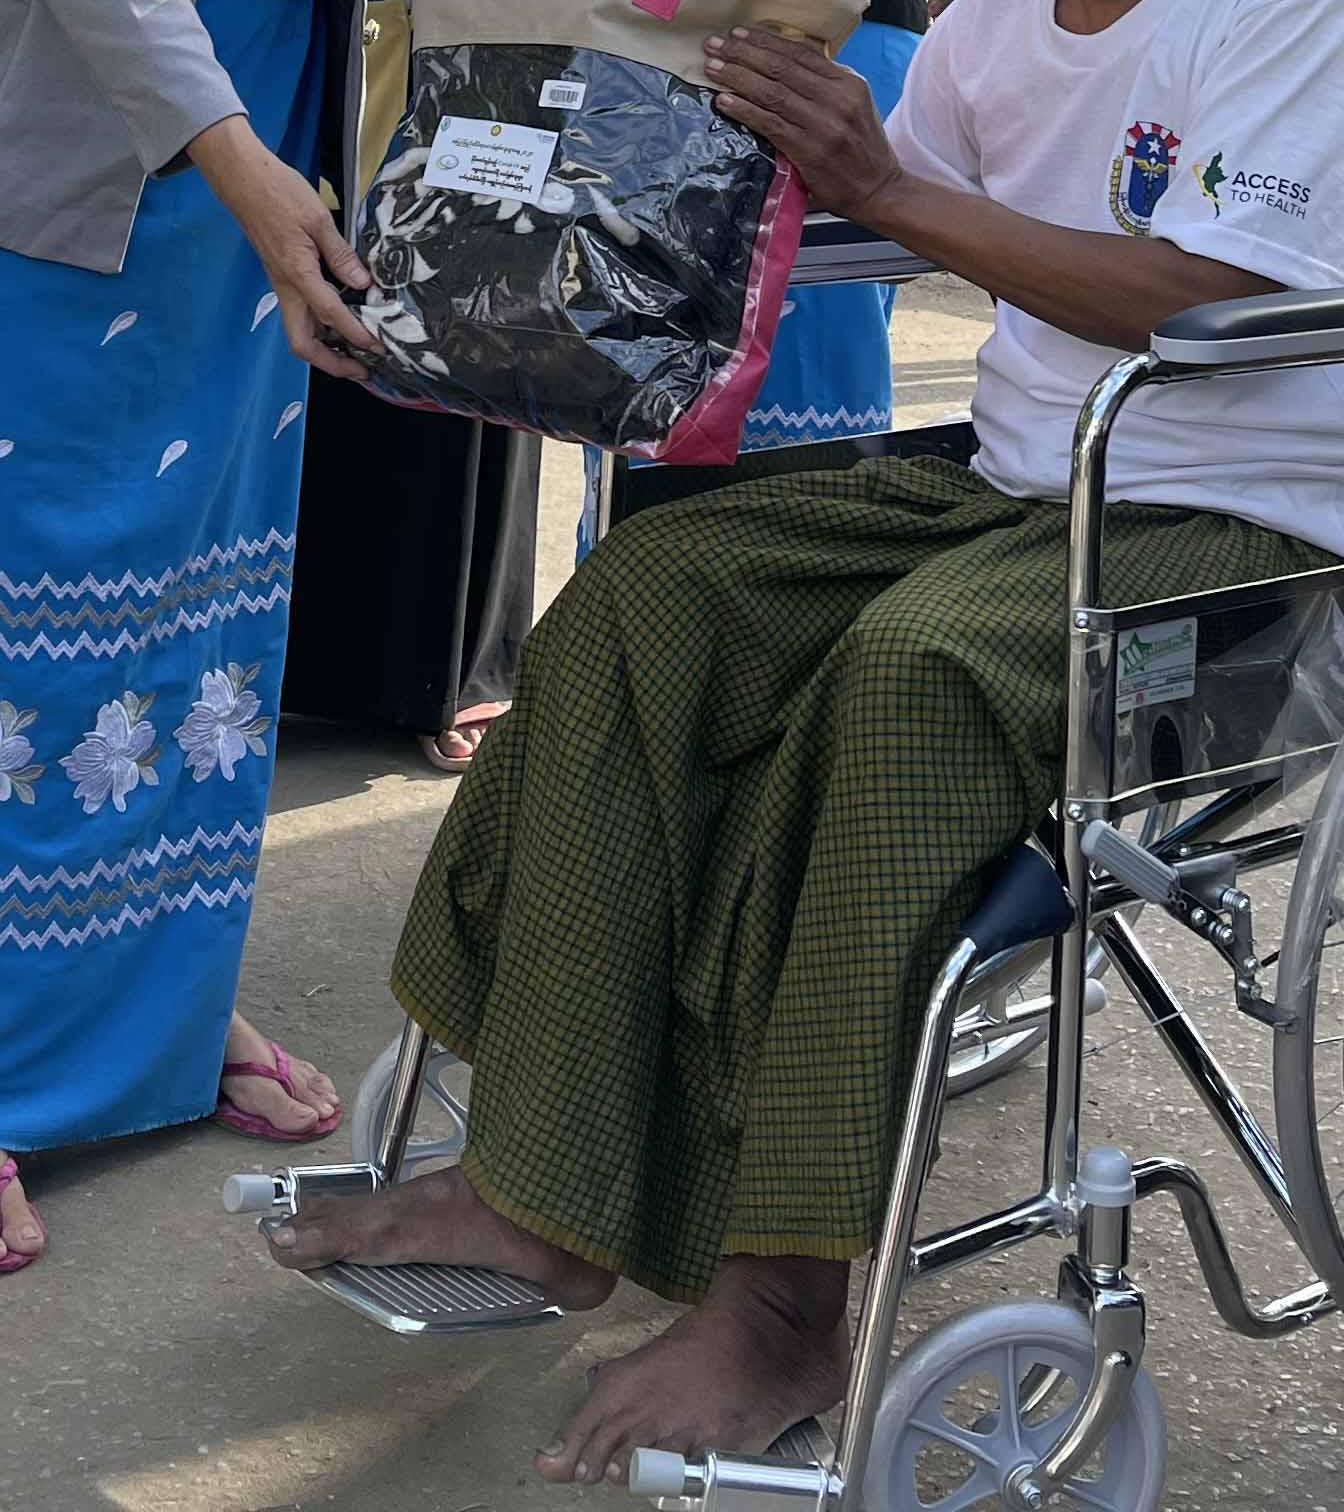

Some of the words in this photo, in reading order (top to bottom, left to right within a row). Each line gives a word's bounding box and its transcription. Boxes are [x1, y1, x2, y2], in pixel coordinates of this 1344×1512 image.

[1232, 170, 1311, 203] ACCESS
[1231, 189, 1252, 203] TO
[1254, 192, 1307, 221] HEALTH
